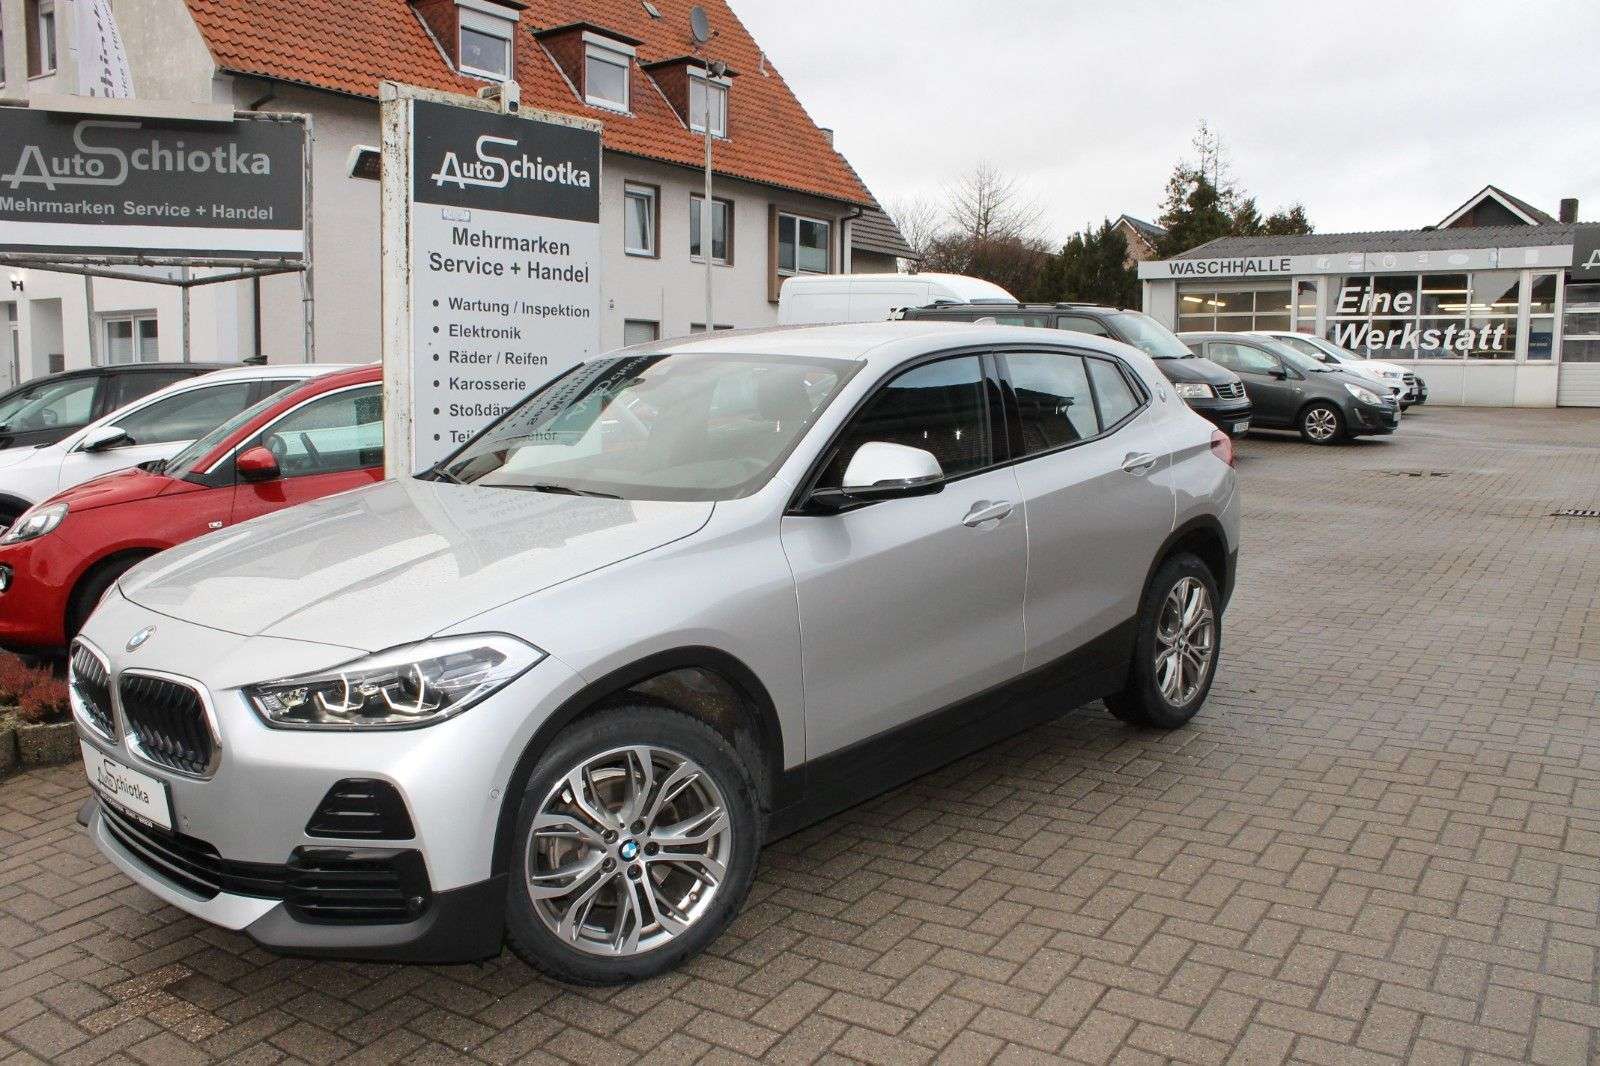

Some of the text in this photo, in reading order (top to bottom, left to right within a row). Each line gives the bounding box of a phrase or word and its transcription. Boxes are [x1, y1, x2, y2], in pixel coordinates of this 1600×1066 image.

[0, 196, 115, 216] Mehrmarken
[123, 201, 190, 217] Service
[212, 204, 273, 220] Handel
[452, 226, 570, 256] Mehrmarken
[429, 252, 504, 276] Service
[527, 261, 589, 283] Handel
[1169, 258, 1291, 275] WASCHHALLE
[449, 297, 510, 316] Wartung
[522, 302, 590, 318] Inspektion
[1336, 286, 1413, 313] Eine
[449, 324, 522, 340] Elektronik
[1334, 322, 1507, 351] Werkstatt
[449, 350, 493, 364] Räder
[505, 352, 548, 365] Reifen
[449, 377, 527, 391] Karosserie
